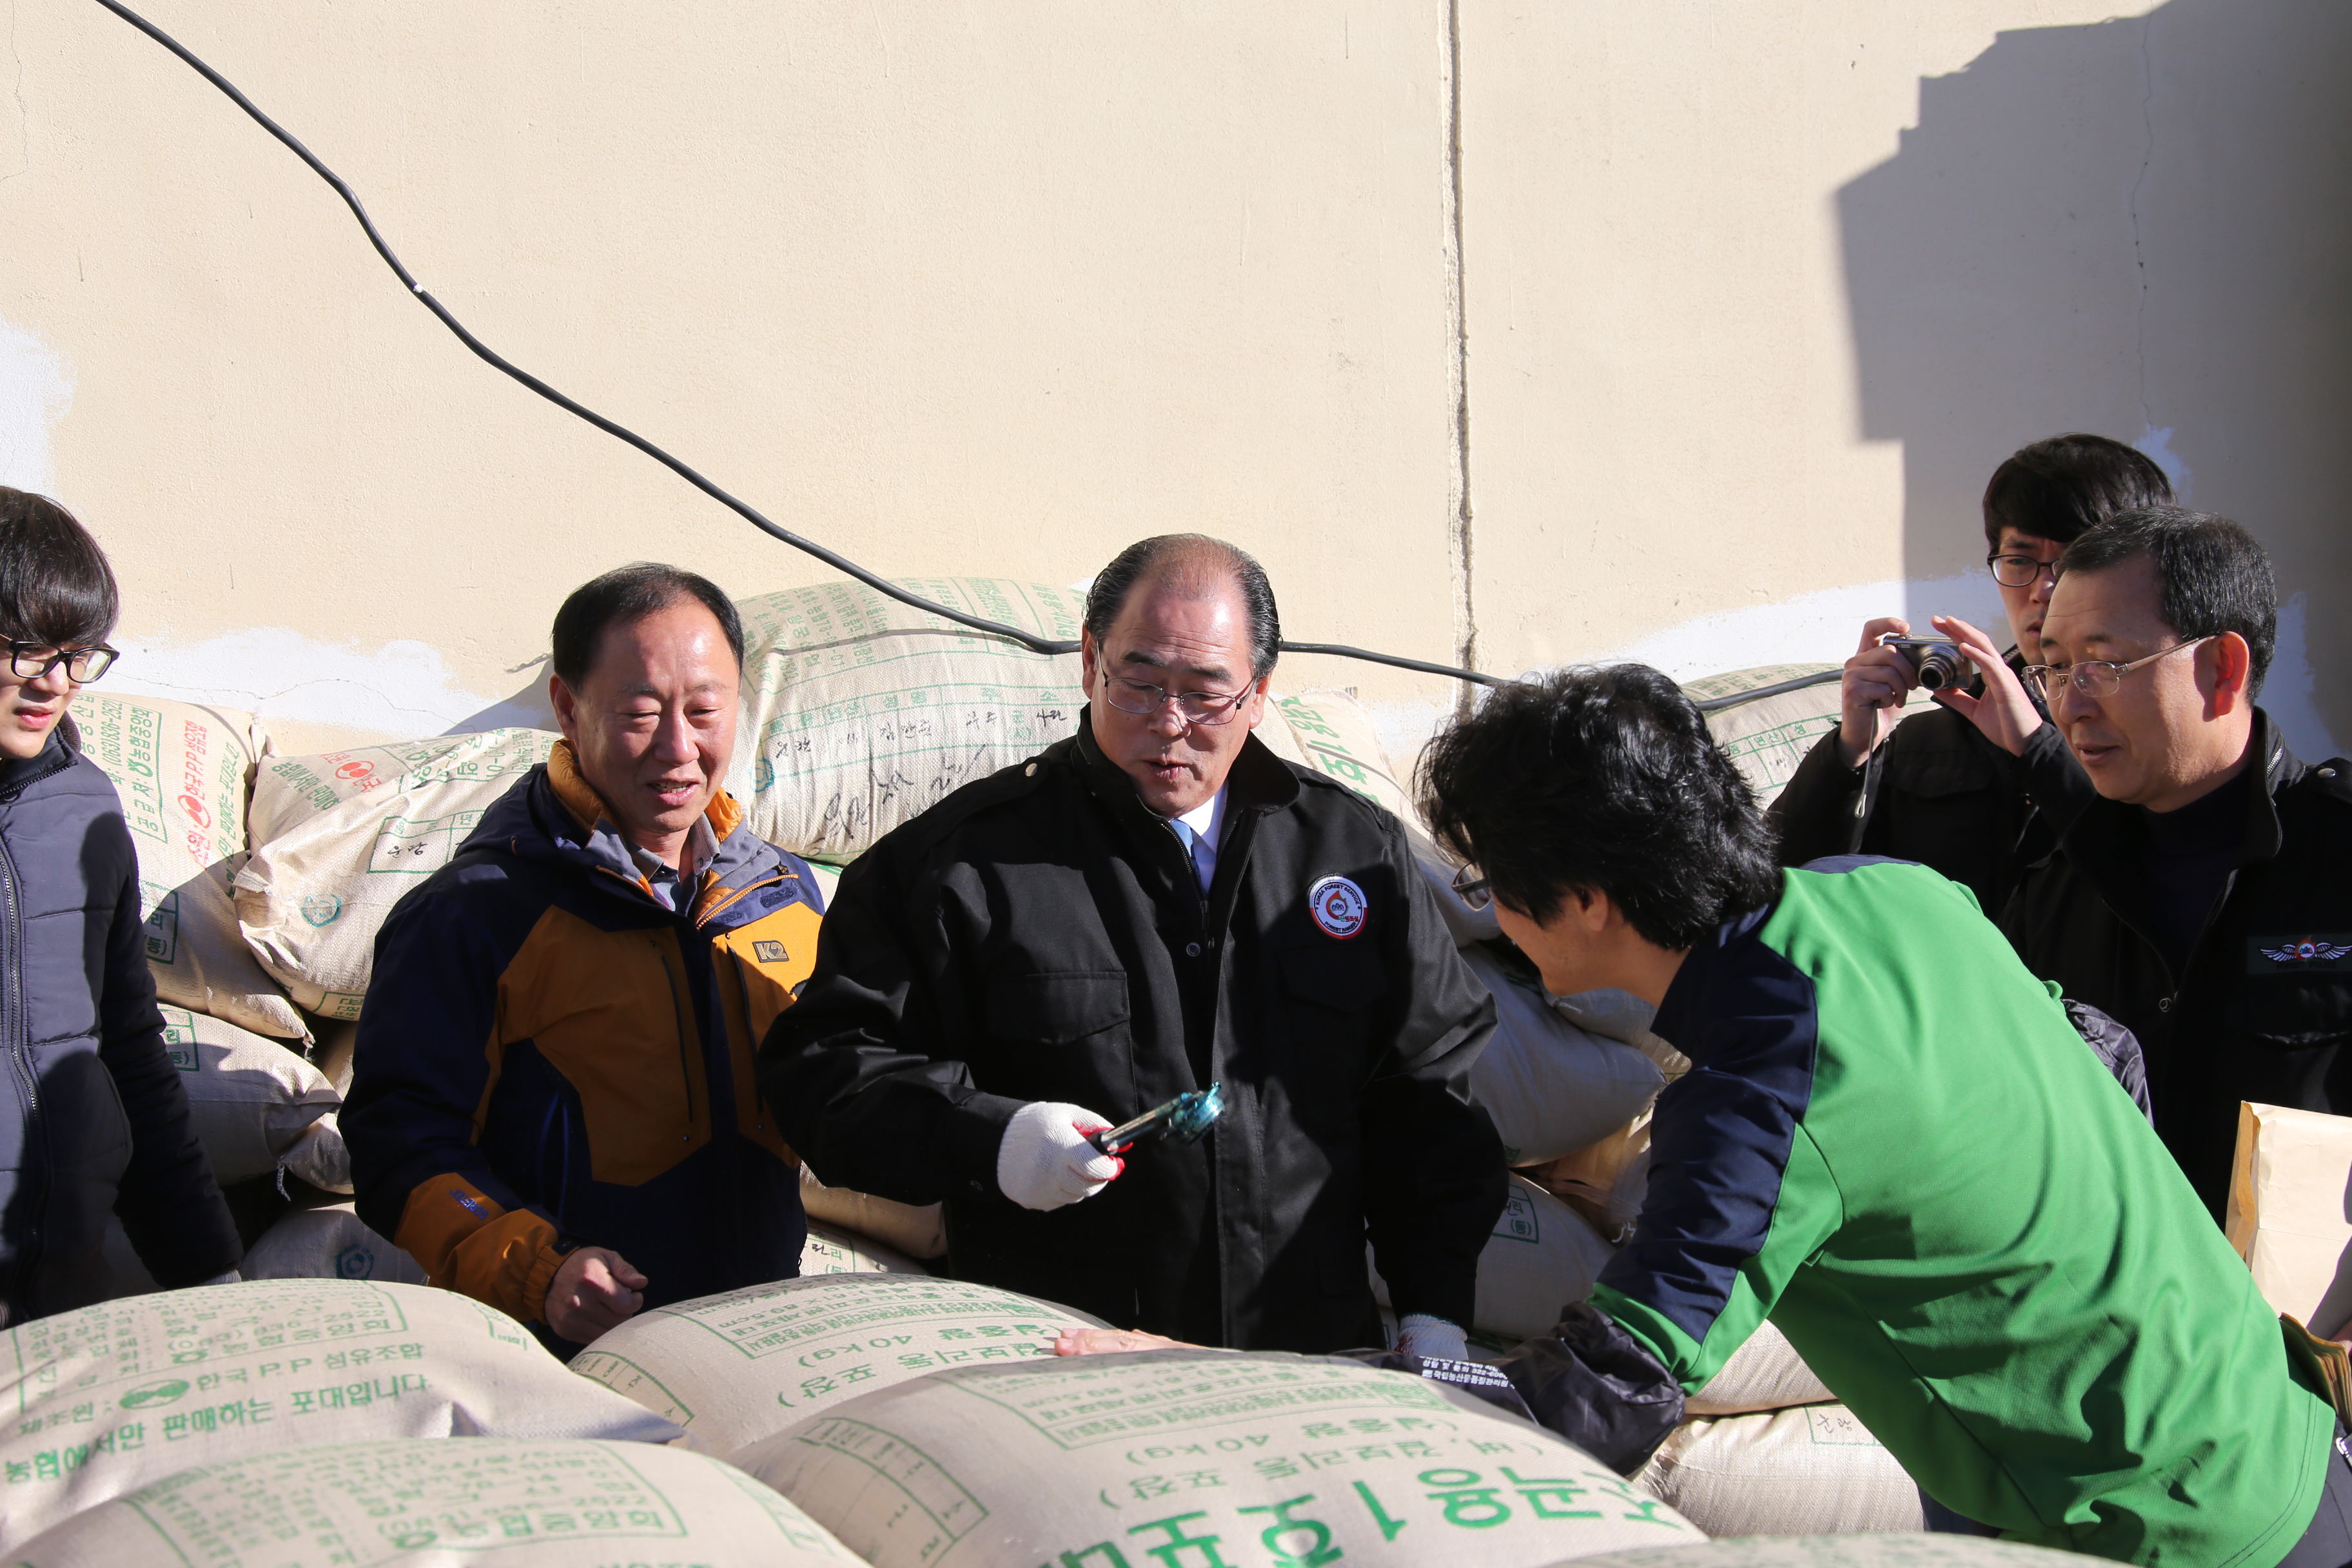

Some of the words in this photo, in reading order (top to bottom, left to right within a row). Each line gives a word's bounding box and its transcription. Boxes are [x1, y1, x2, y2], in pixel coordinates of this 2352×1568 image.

[1315, 888, 1325, 905] KOREA
[1344, 886, 1360, 905] SERVICE
[754, 941, 788, 960] K2
[162, 1396, 275, 1441] 판매하는
